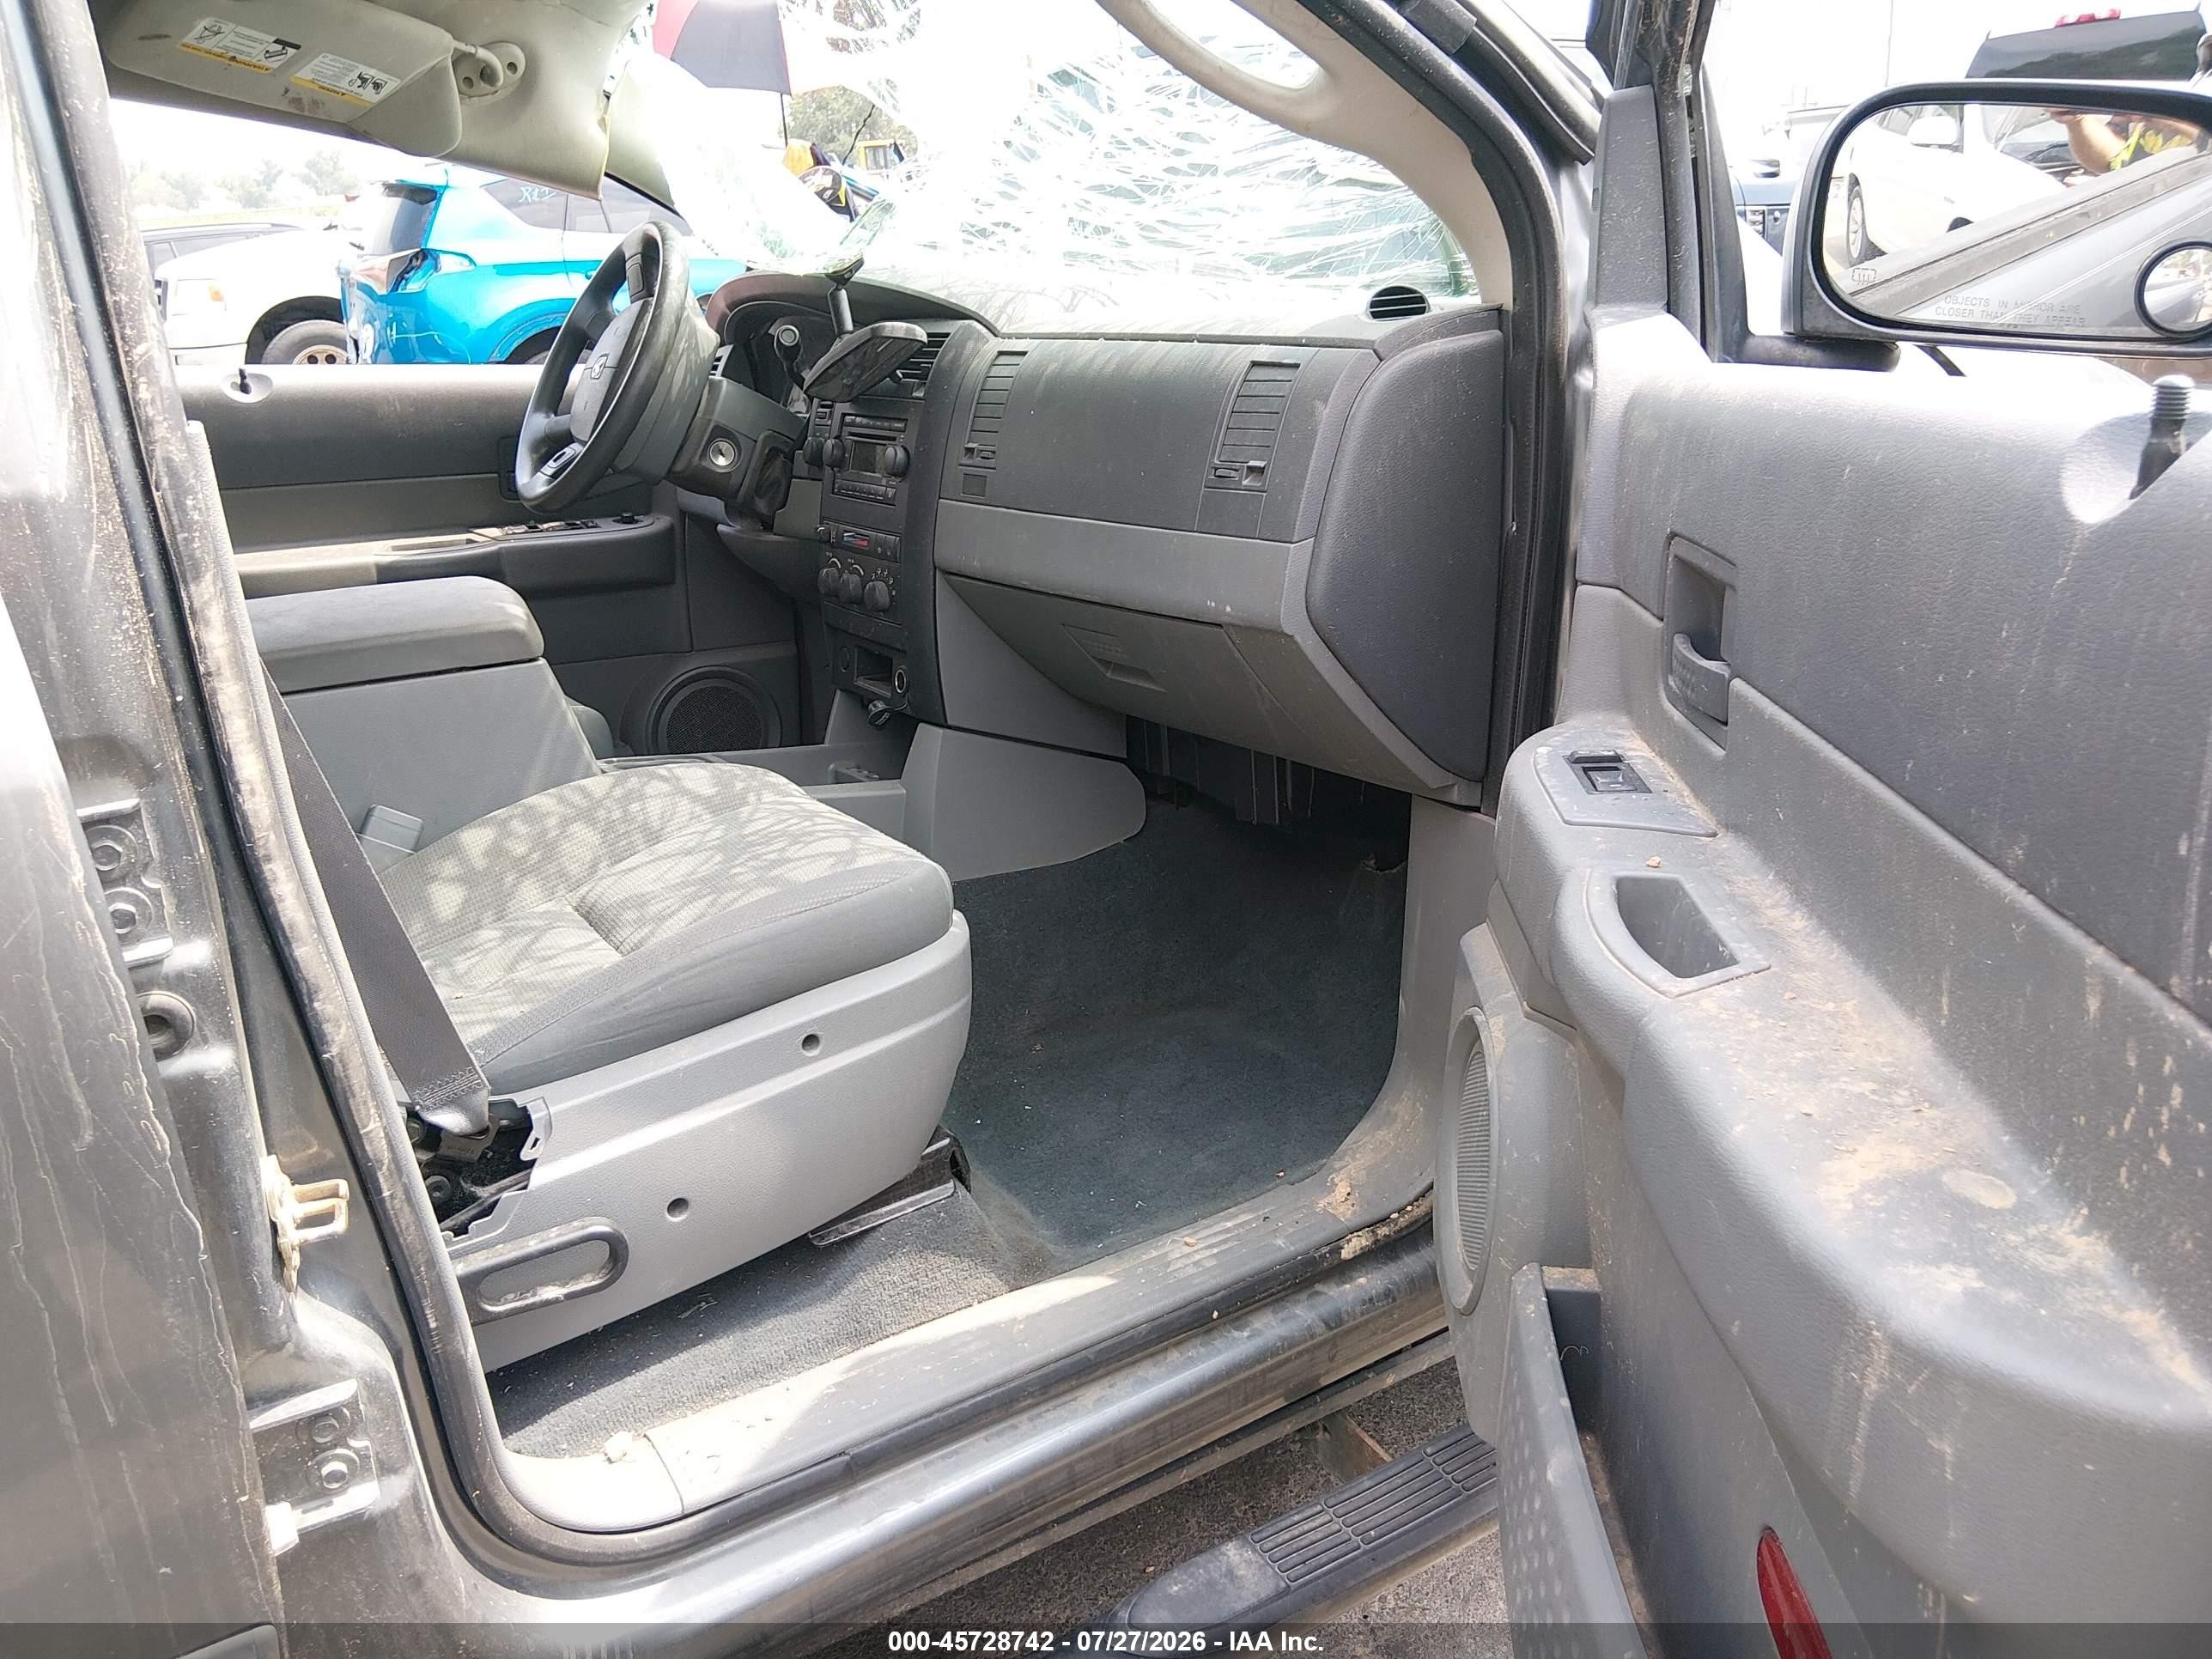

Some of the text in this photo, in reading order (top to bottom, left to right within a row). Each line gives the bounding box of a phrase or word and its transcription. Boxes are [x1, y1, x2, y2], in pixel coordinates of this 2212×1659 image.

[1944, 295, 1990, 307] OBJECTS
[1998, 299, 2008, 308] IN
[1936, 306, 1974, 318] CLOSER
[1980, 310, 2008, 320] THAN
[2014, 313, 2039, 324] THEY
